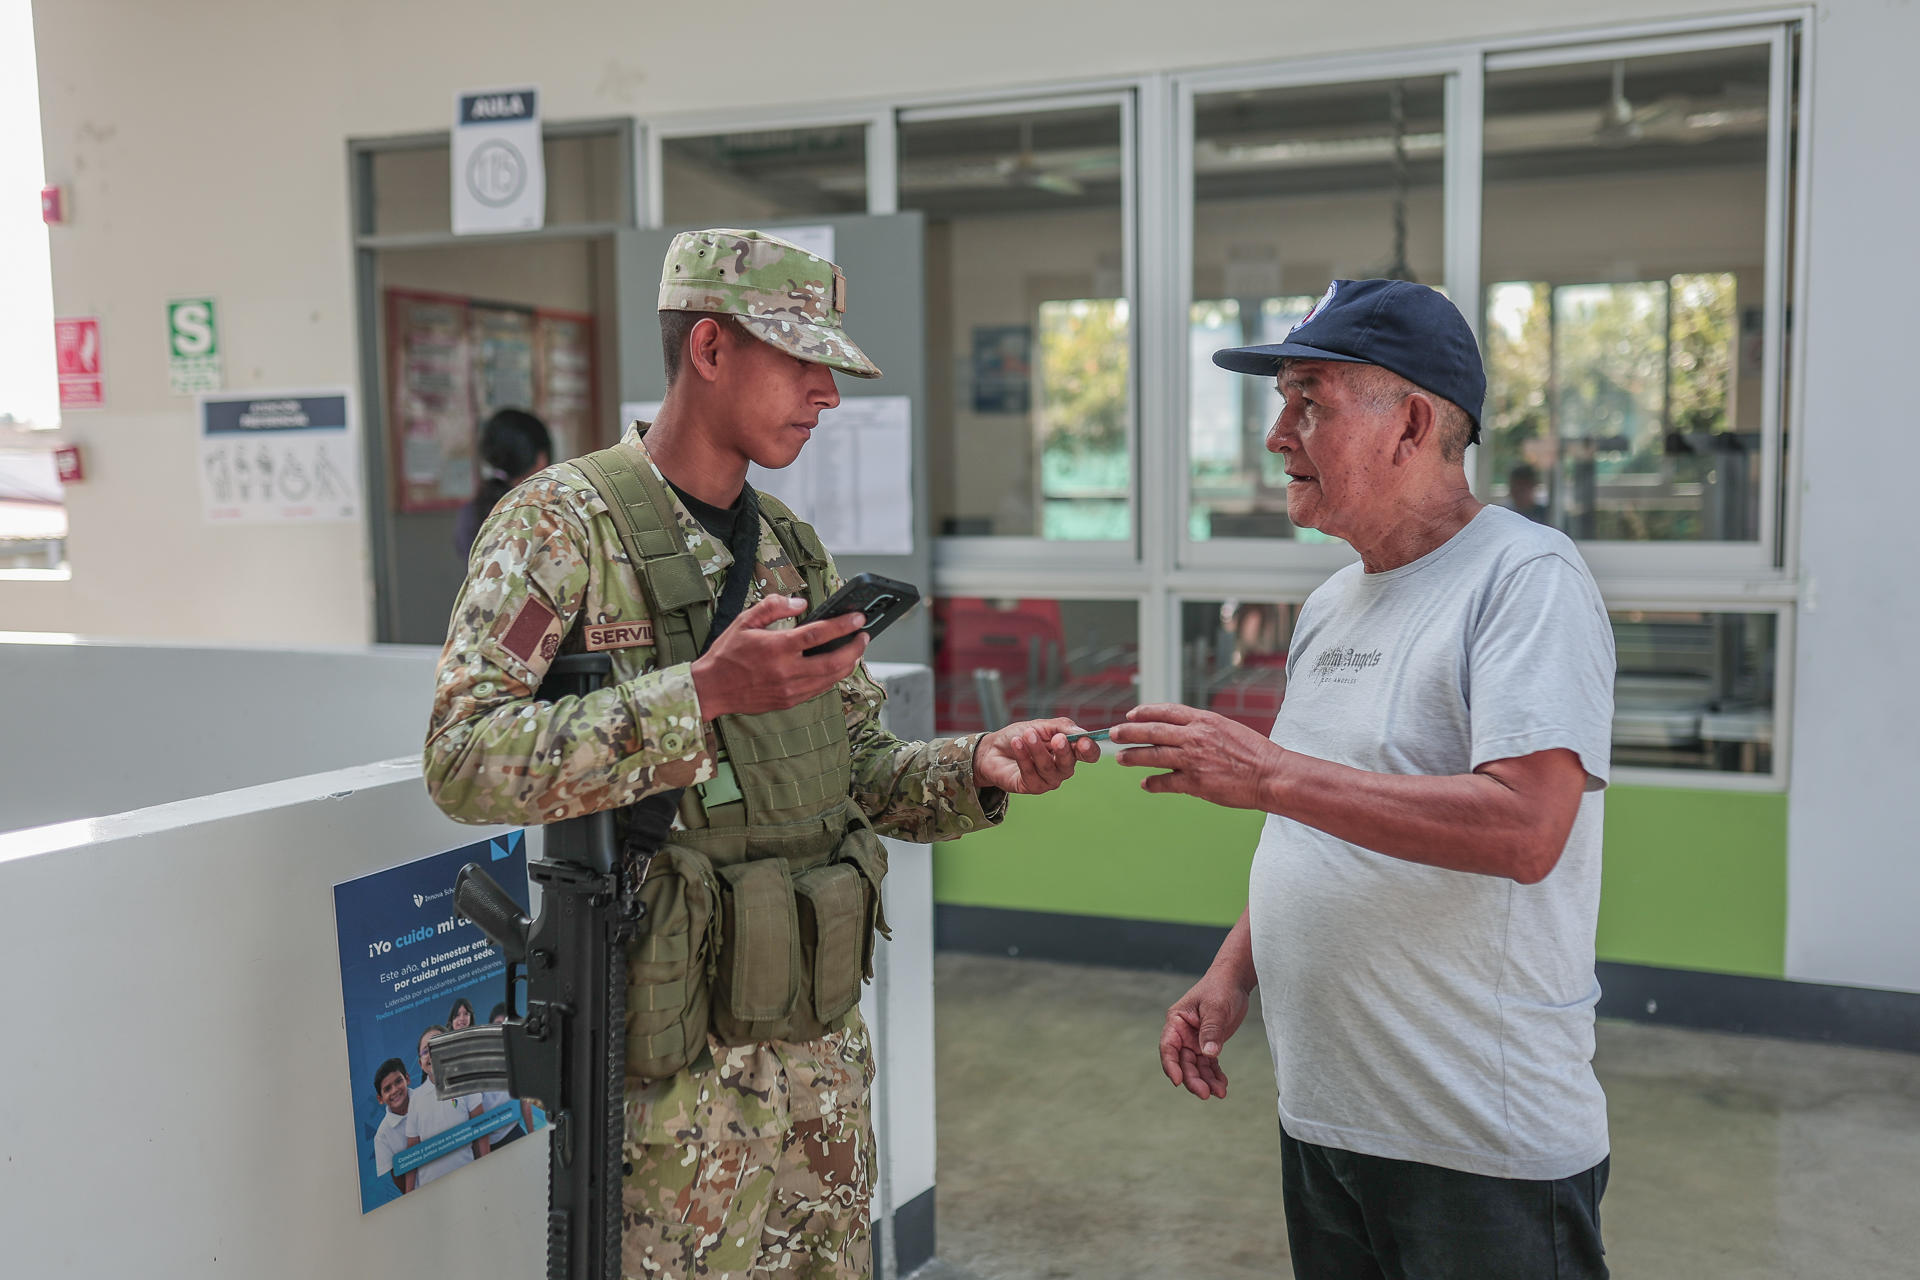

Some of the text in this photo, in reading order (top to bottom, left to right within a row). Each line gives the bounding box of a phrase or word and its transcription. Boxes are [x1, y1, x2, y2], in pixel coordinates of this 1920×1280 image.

[471, 94, 526, 119] AULA
[174, 302, 212, 355] S
[1341, 648, 1383, 673] Angels
[425, 892, 444, 902] Innova
[368, 940, 392, 958] ¡Yo
[395, 926, 434, 948] cuido
[437, 916, 455, 935] mi
[380, 970, 400, 984] Este
[420, 957, 429, 968] el
[431, 945, 470, 966] bienestar
[394, 948, 496, 993] por cuidar nuestra sede.
[384, 994, 411, 1009] Liderada
[412, 991, 422, 1000] por
